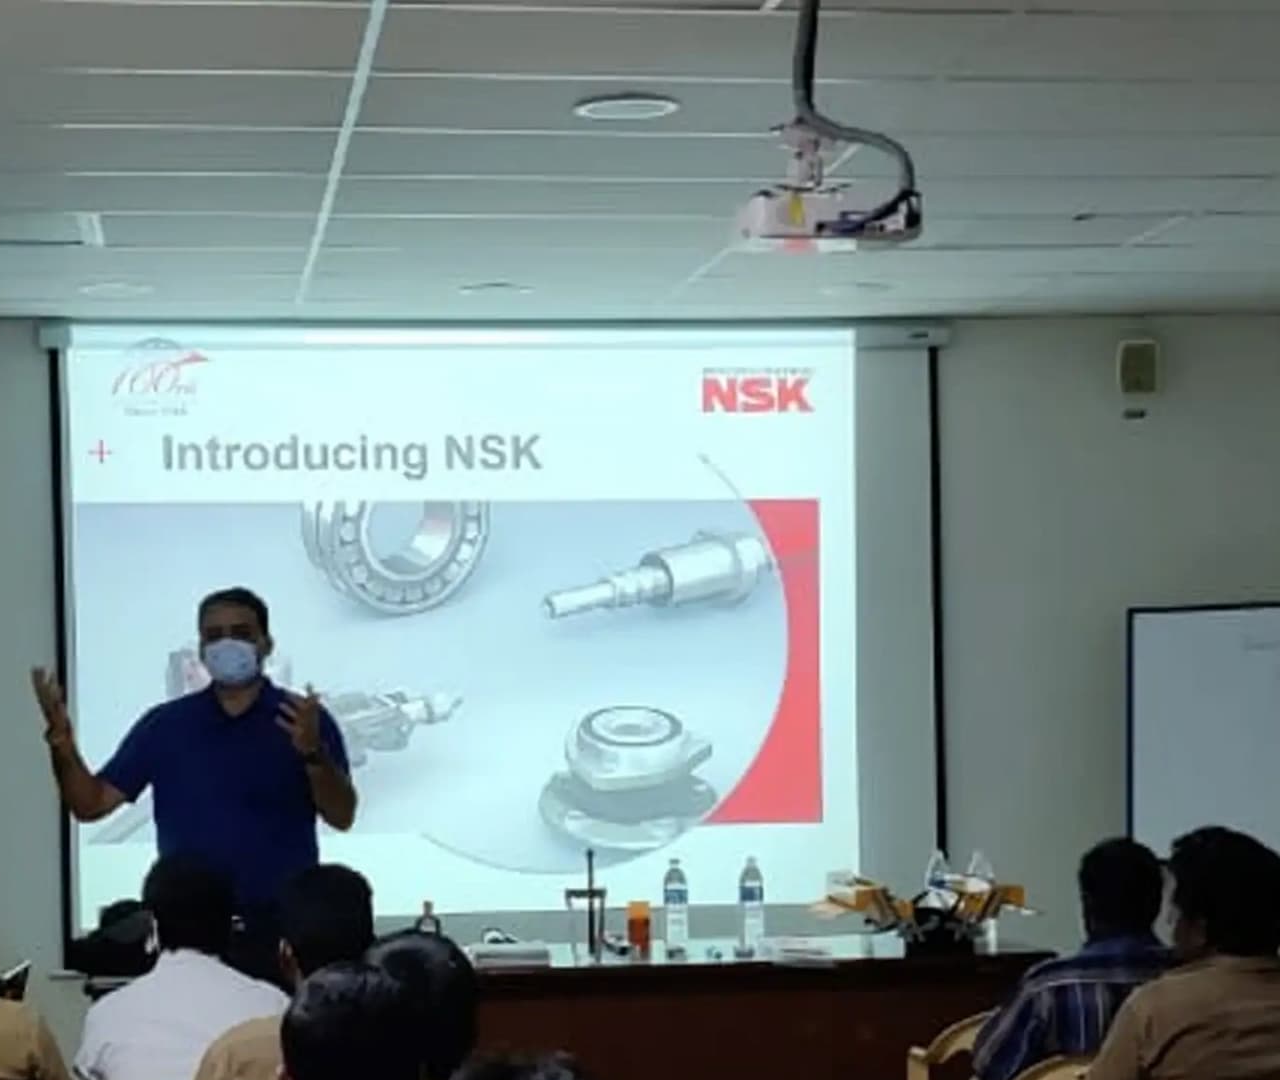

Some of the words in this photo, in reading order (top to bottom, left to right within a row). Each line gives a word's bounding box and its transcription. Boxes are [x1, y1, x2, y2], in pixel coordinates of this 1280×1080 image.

[702, 377, 816, 413] NSK
[161, 434, 429, 481] Introducing
[444, 434, 543, 470] NSK
